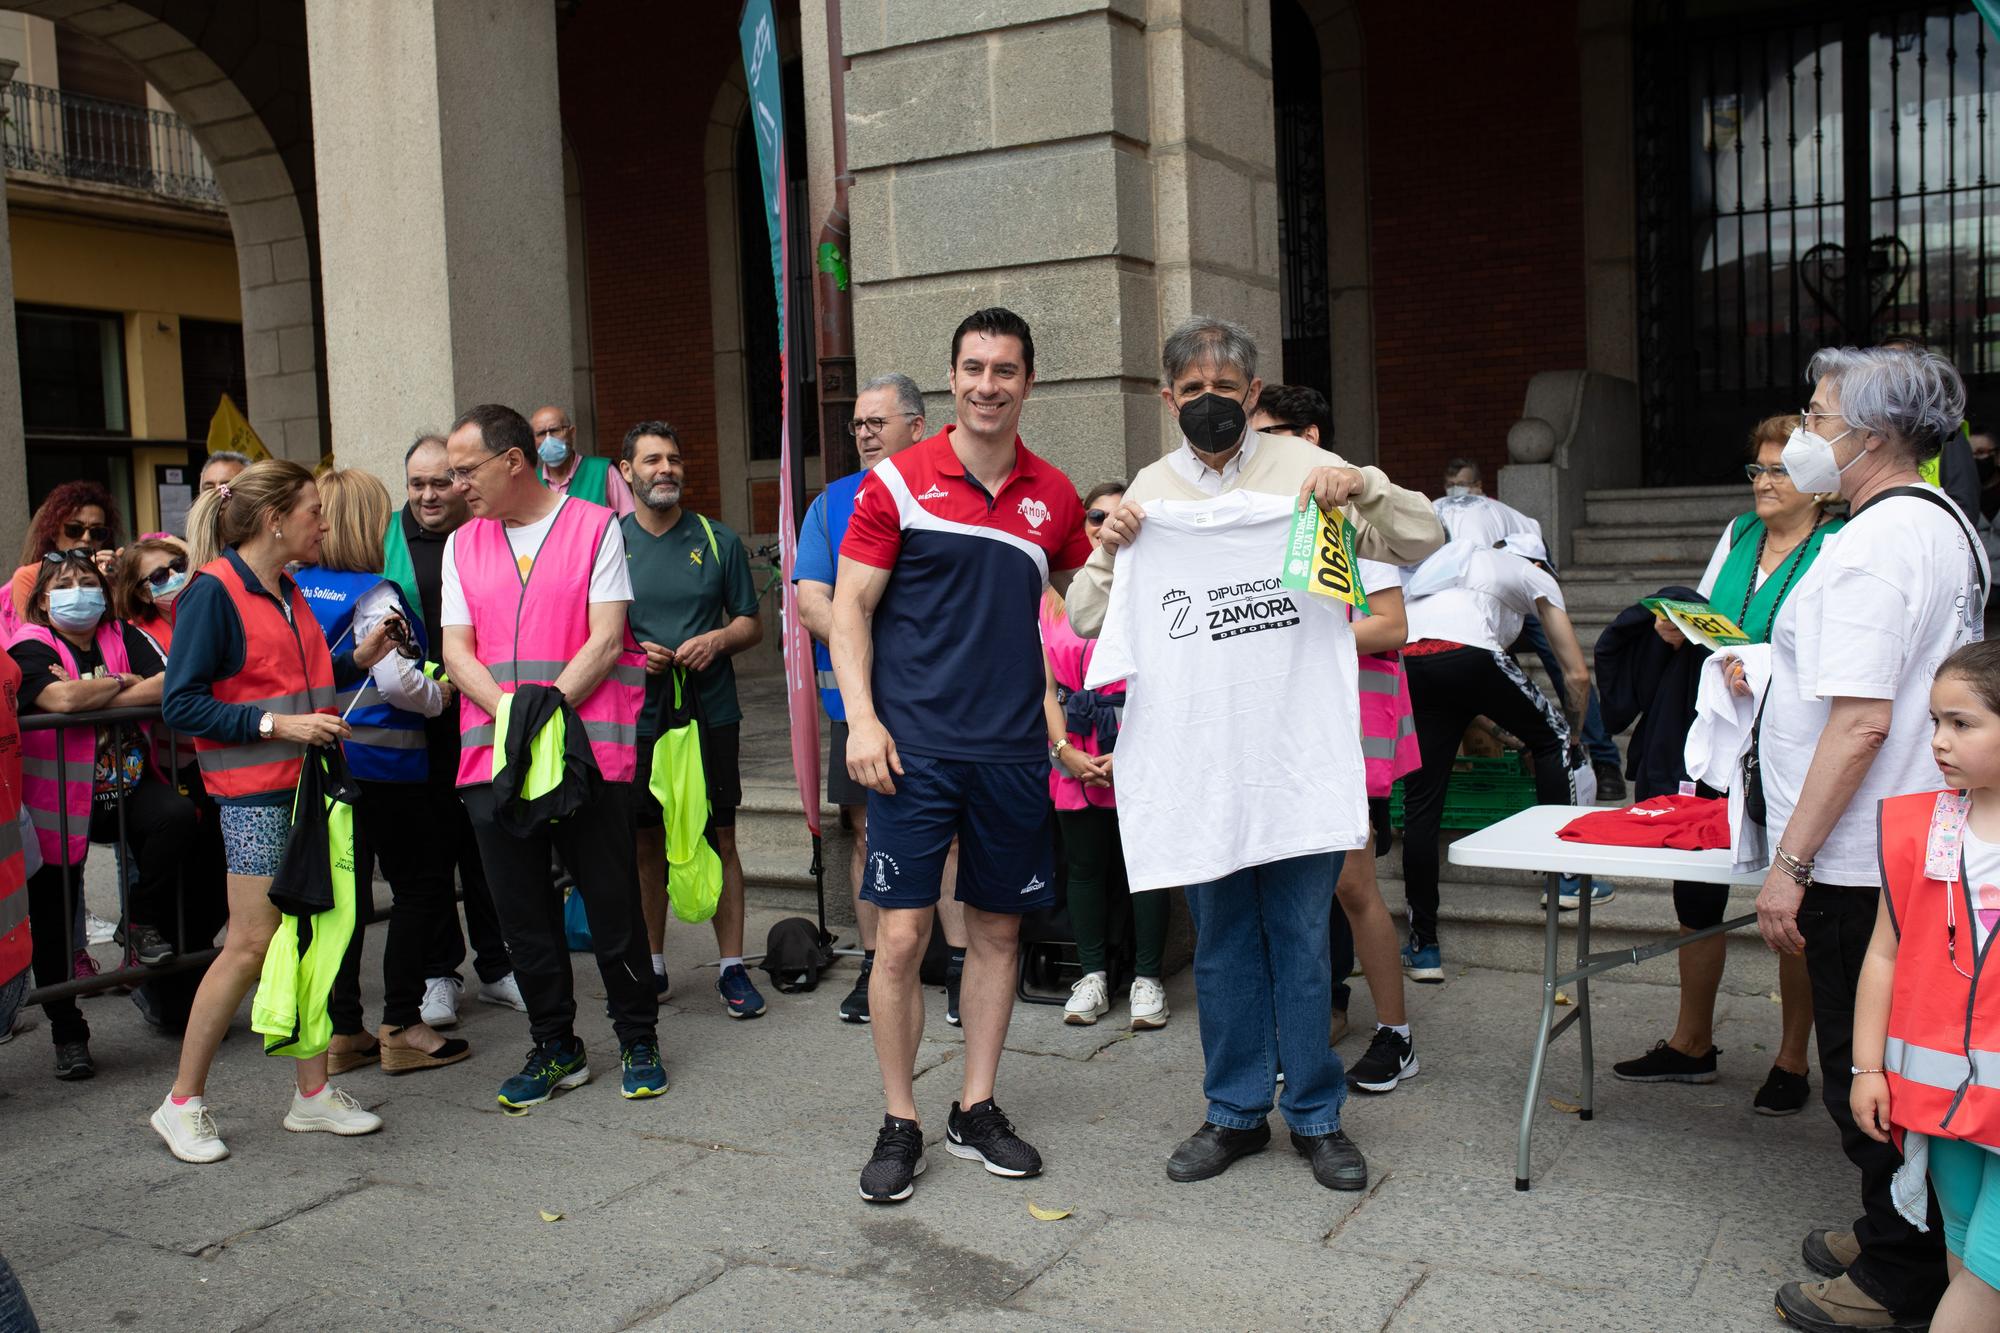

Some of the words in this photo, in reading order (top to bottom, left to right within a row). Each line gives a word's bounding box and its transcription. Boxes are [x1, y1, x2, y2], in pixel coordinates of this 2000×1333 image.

[1017, 503, 1052, 522] ZAMORA
[313, 586, 347, 602] Solidaria
[1205, 596, 1298, 630] ZAMORA
[1219, 619, 1293, 639] DEPORTES
